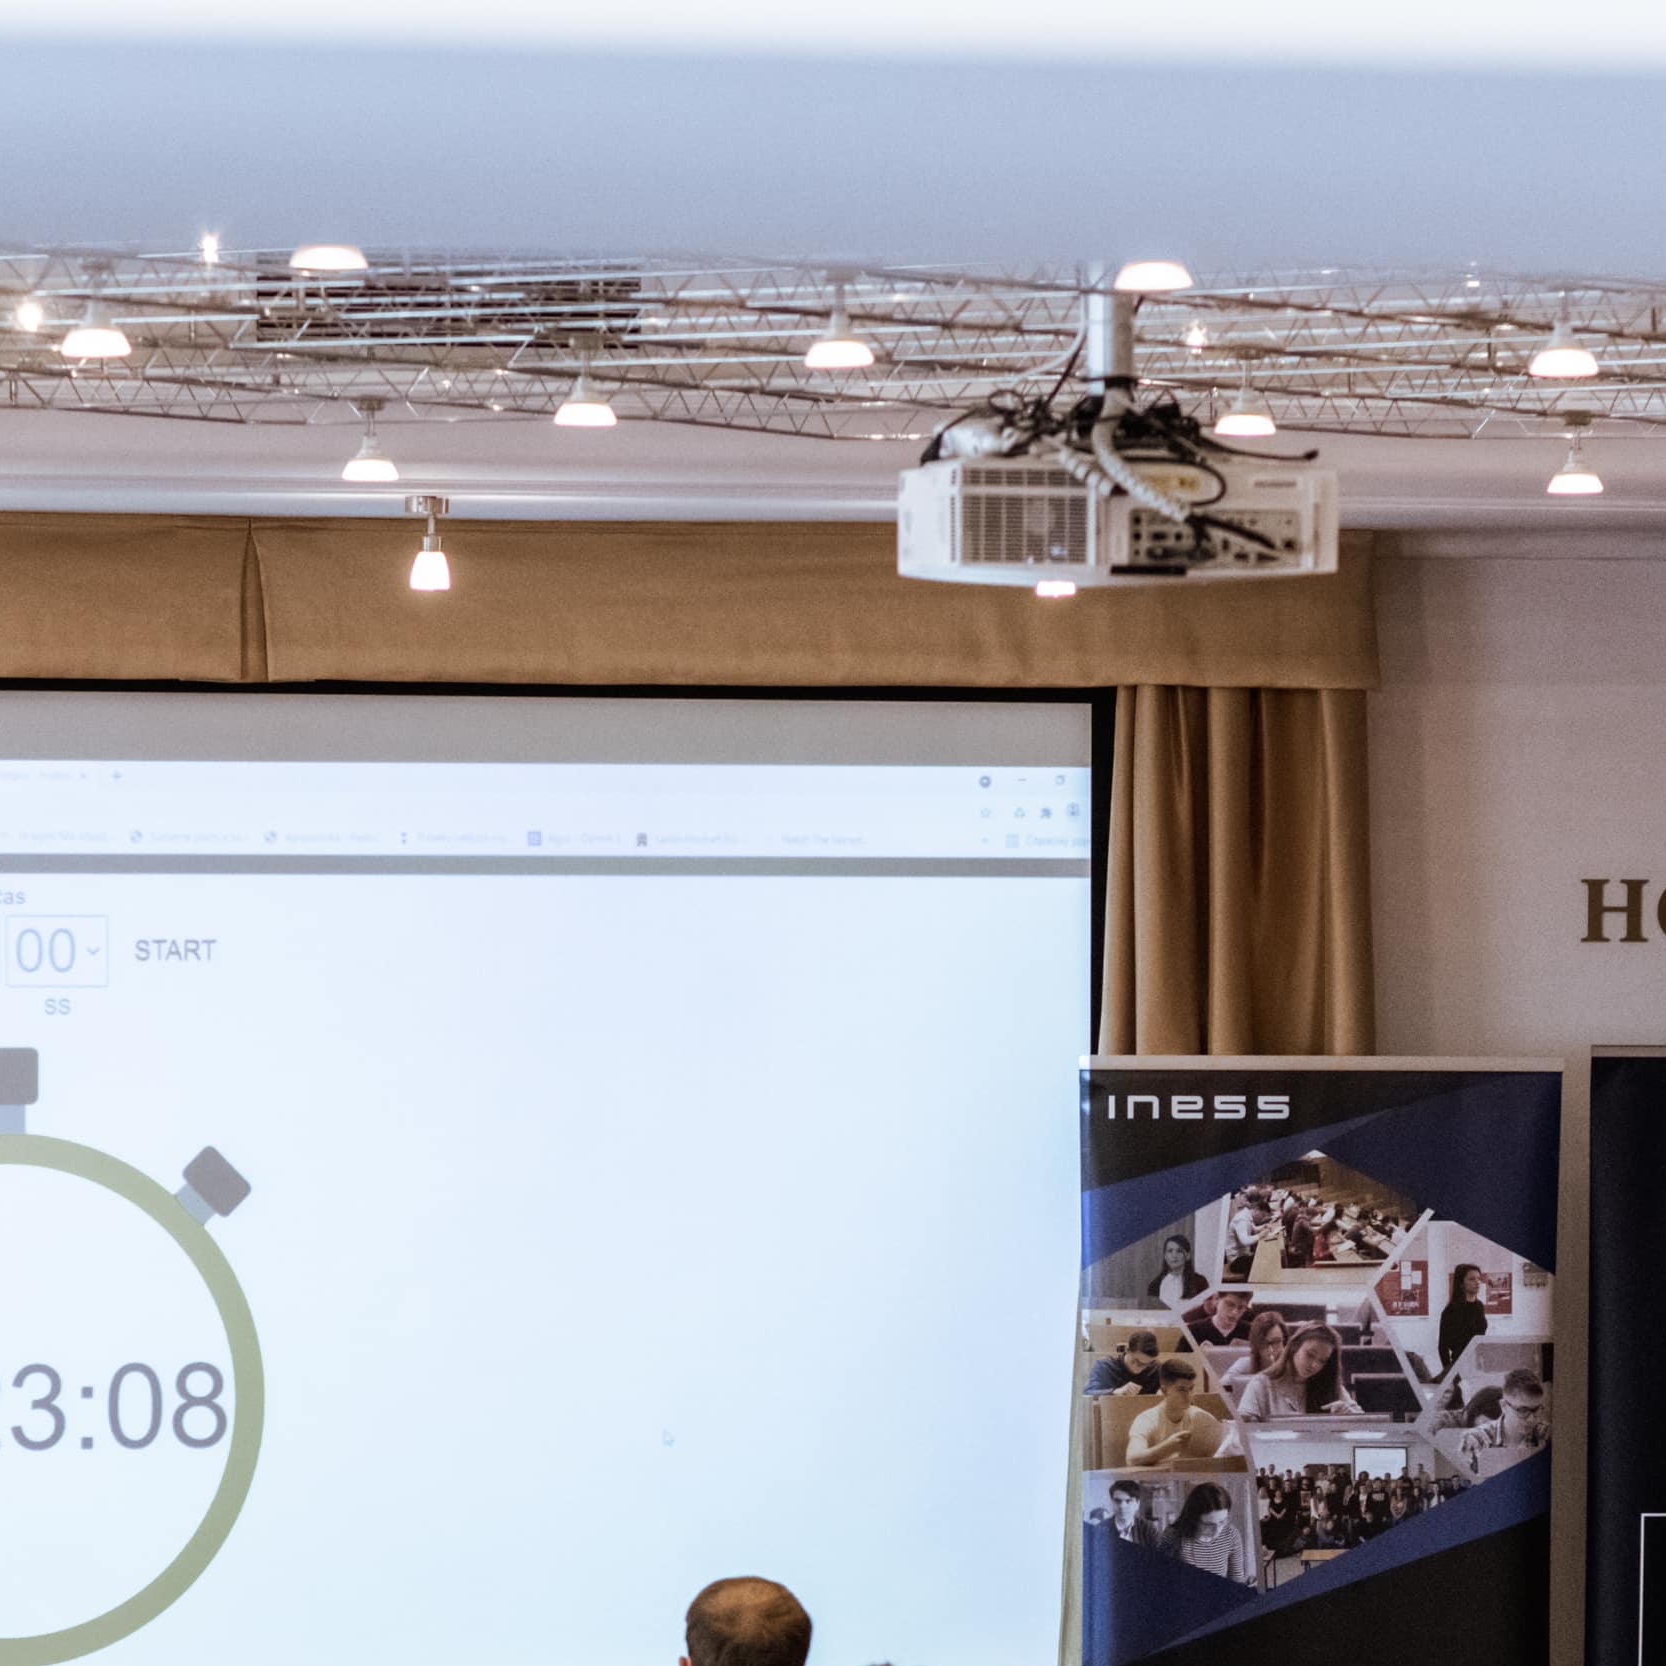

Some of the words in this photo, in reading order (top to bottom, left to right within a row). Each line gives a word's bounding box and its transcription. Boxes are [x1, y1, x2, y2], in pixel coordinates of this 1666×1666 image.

[15, 927, 77, 974] 00
[134, 939, 217, 961] START
[44, 998, 71, 1015] SS
